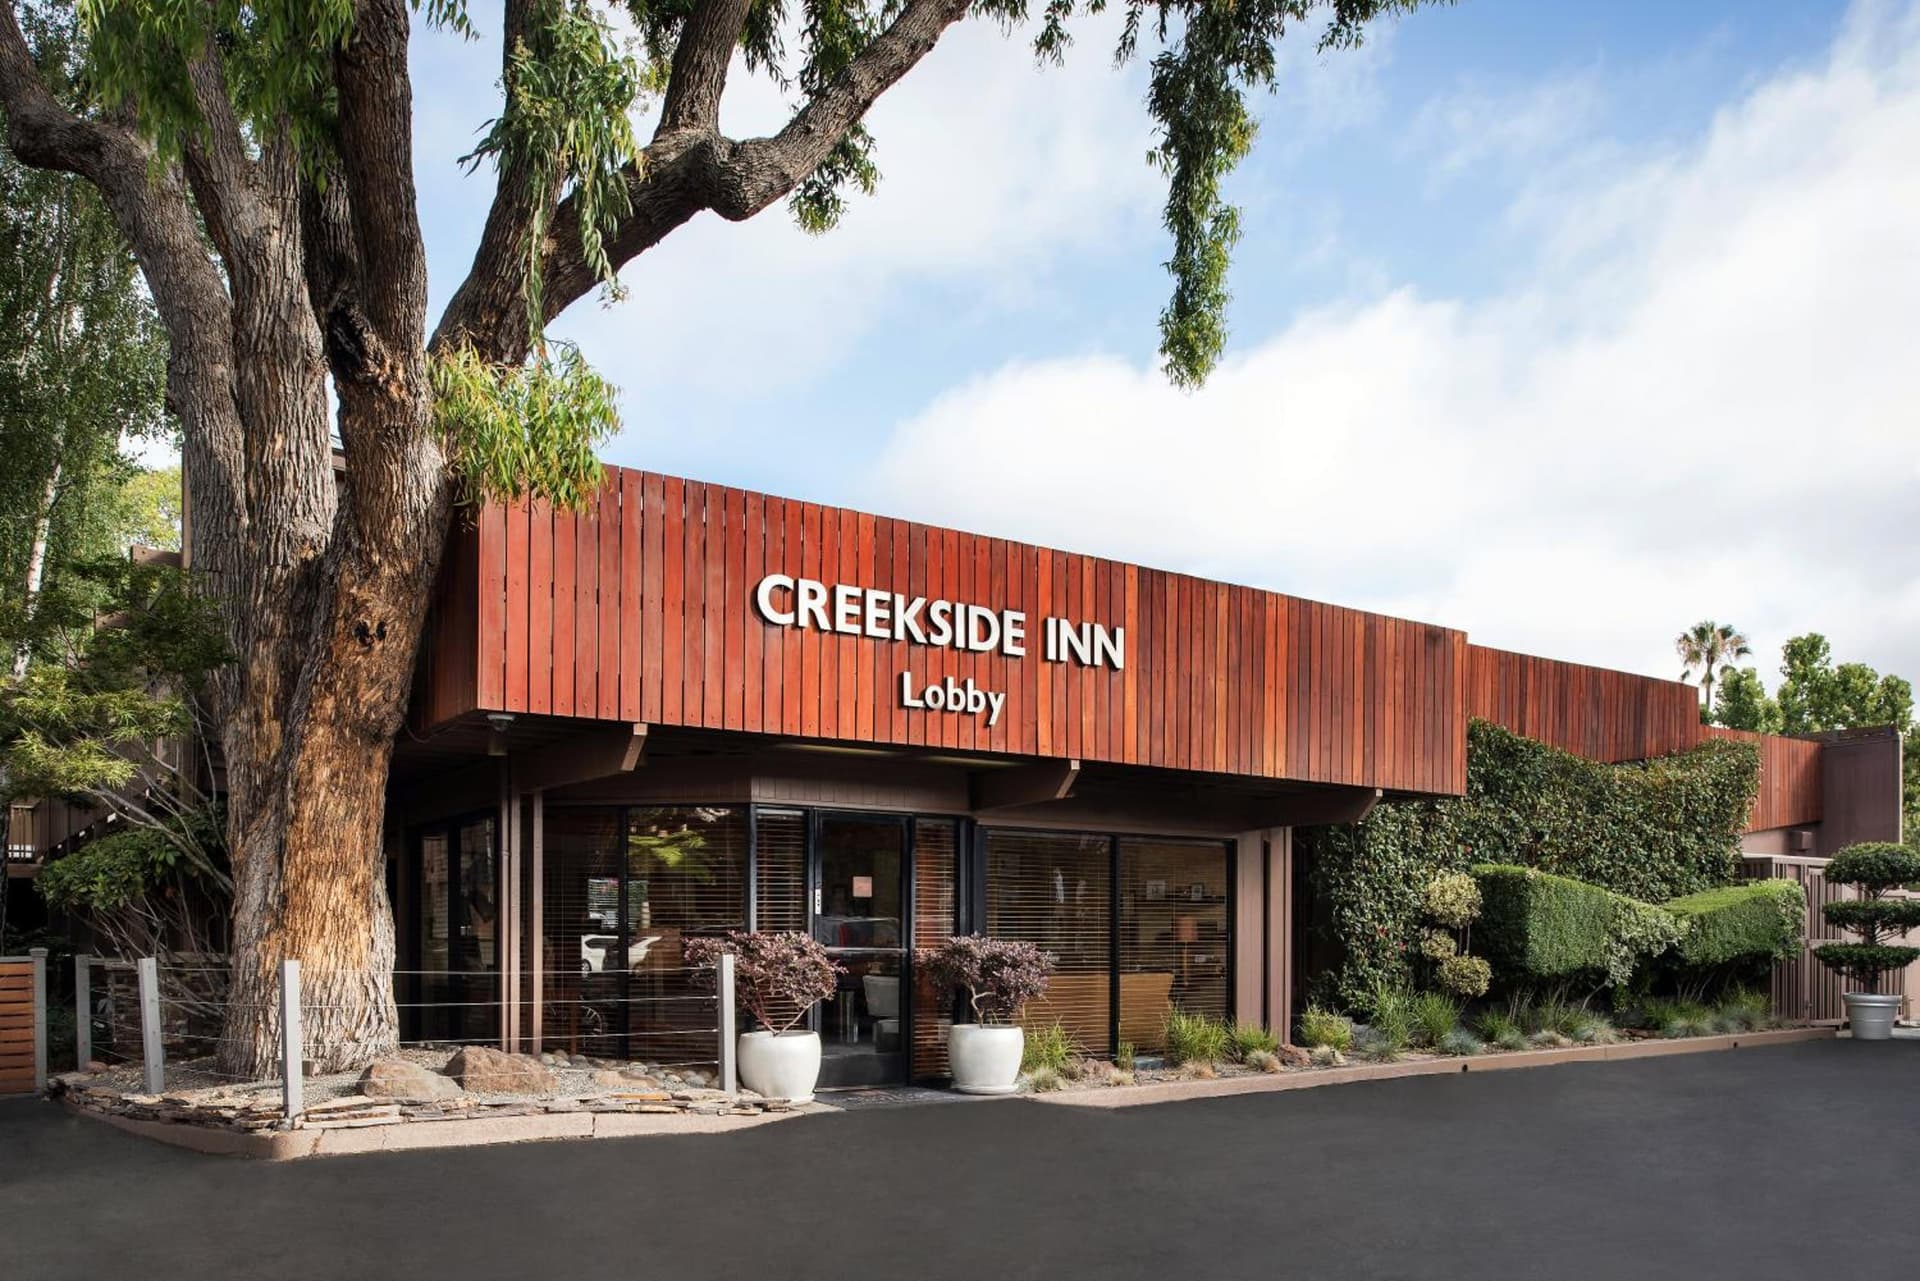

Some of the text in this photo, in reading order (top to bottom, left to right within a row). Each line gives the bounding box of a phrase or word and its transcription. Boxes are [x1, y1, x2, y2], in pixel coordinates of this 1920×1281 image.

[756, 574, 1125, 669] CREEKSIDE INN
[902, 671, 1006, 726] Lobby
